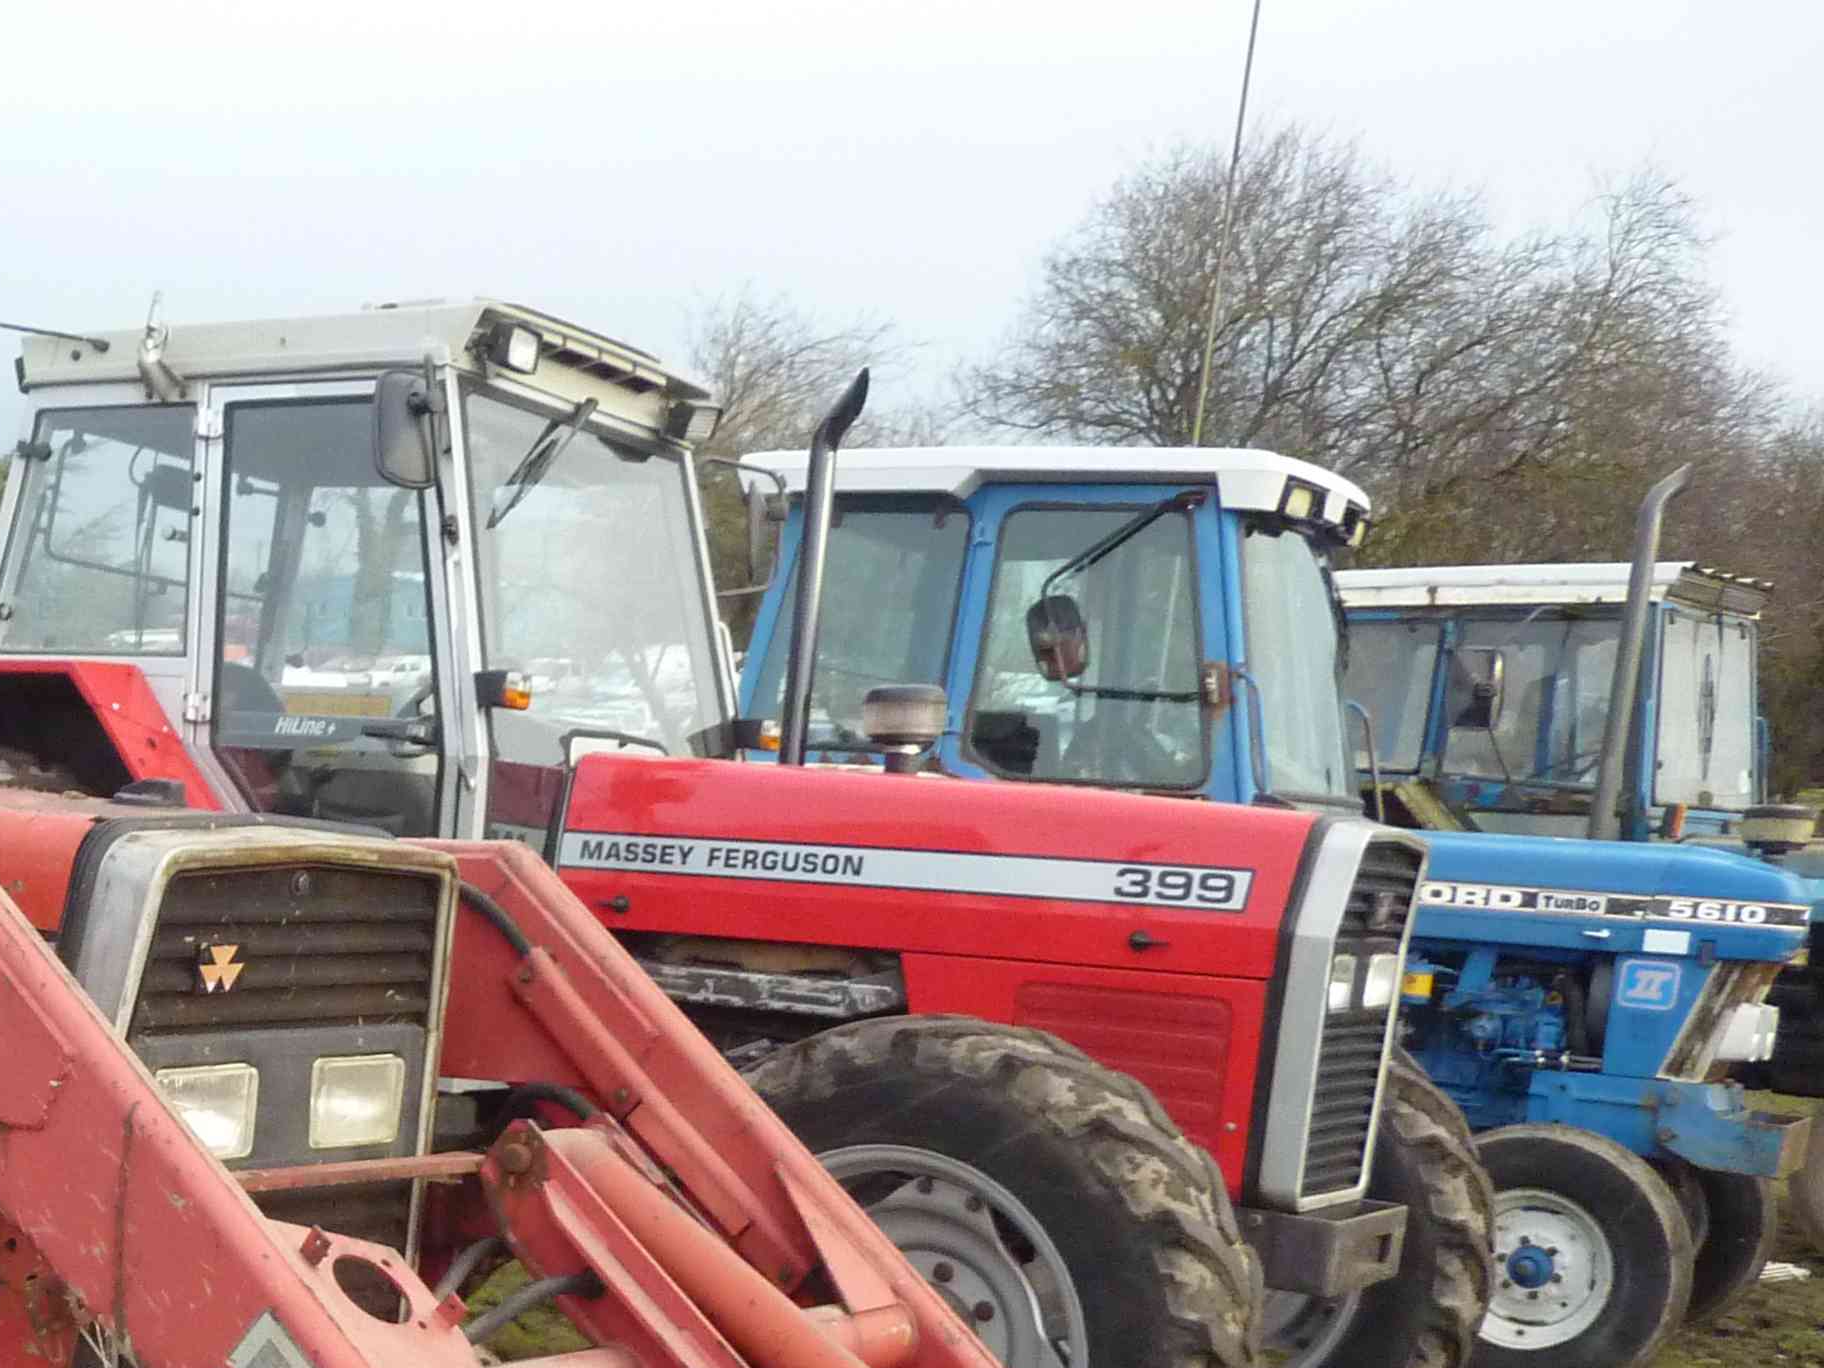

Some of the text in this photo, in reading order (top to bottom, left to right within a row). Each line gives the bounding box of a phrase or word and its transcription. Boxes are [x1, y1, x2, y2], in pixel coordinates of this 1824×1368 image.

[578, 839, 1236, 904] MASSEY FERGUSON 399
[1668, 900, 1766, 924] 5610
